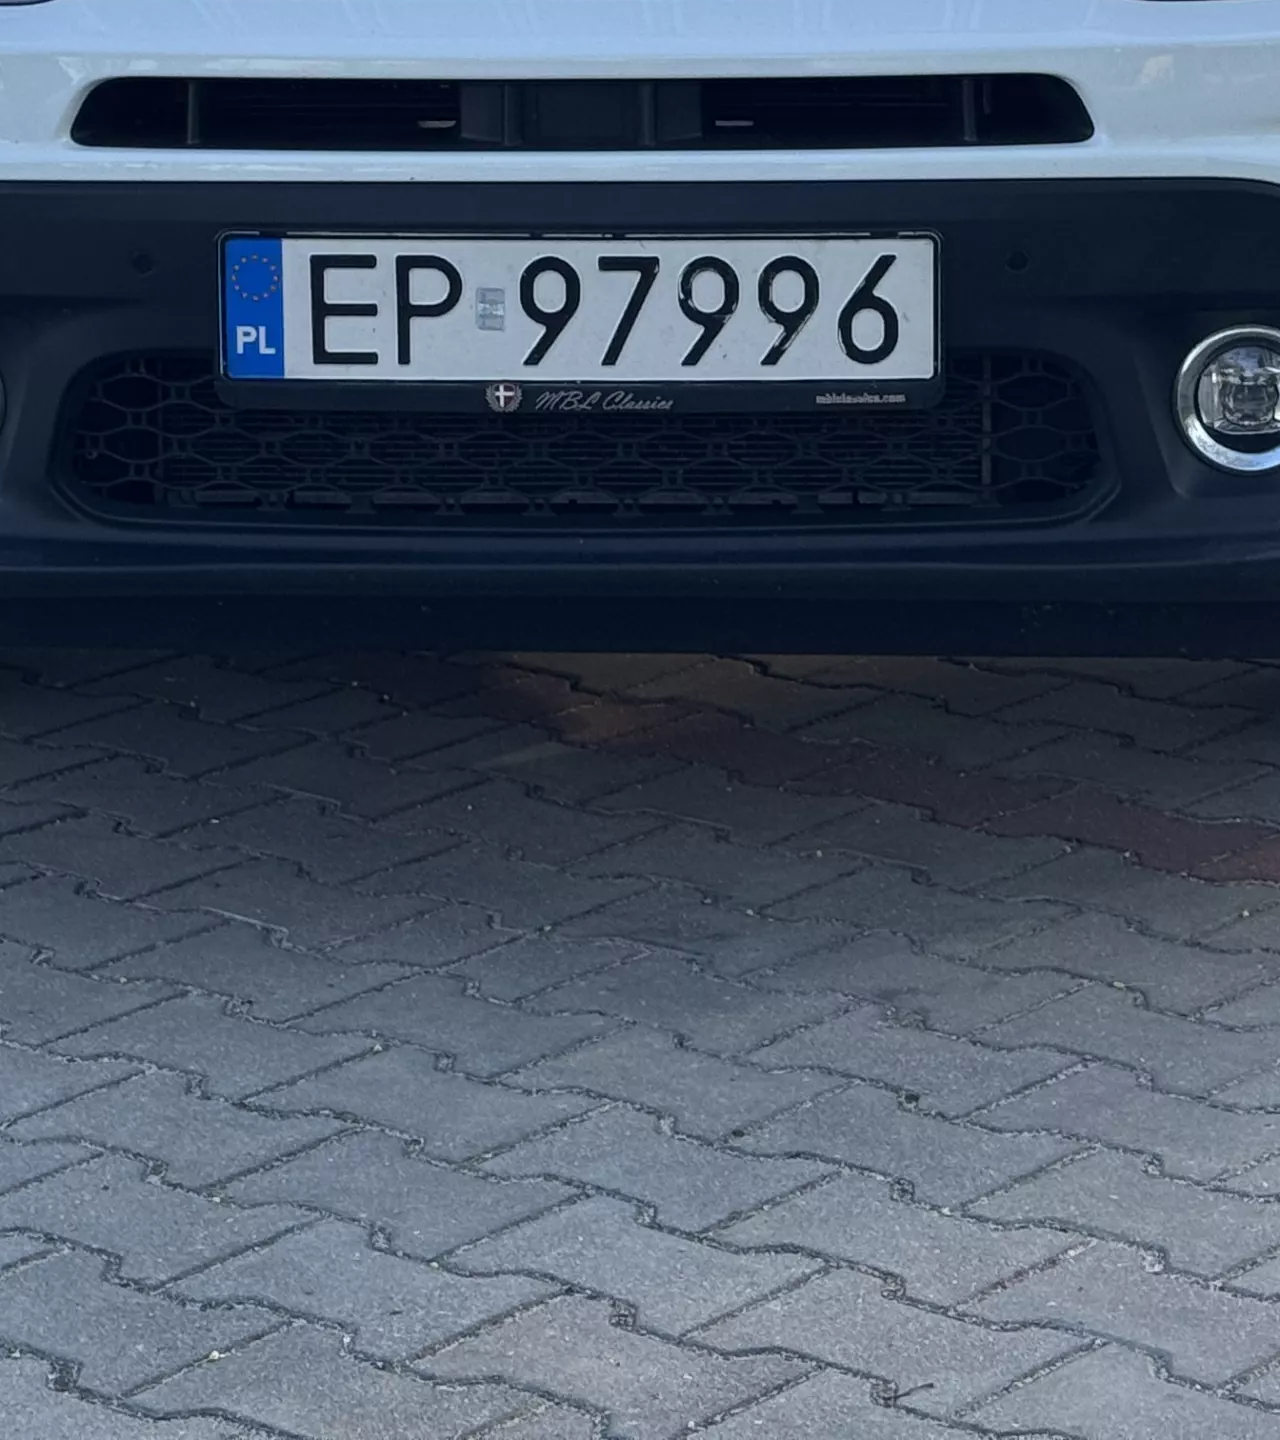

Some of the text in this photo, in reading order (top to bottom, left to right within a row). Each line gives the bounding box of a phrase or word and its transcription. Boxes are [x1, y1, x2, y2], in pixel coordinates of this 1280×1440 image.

[309, 253, 900, 366] EP 97996
[236, 326, 276, 356] PL
[535, 390, 674, 410] MBL Classics
